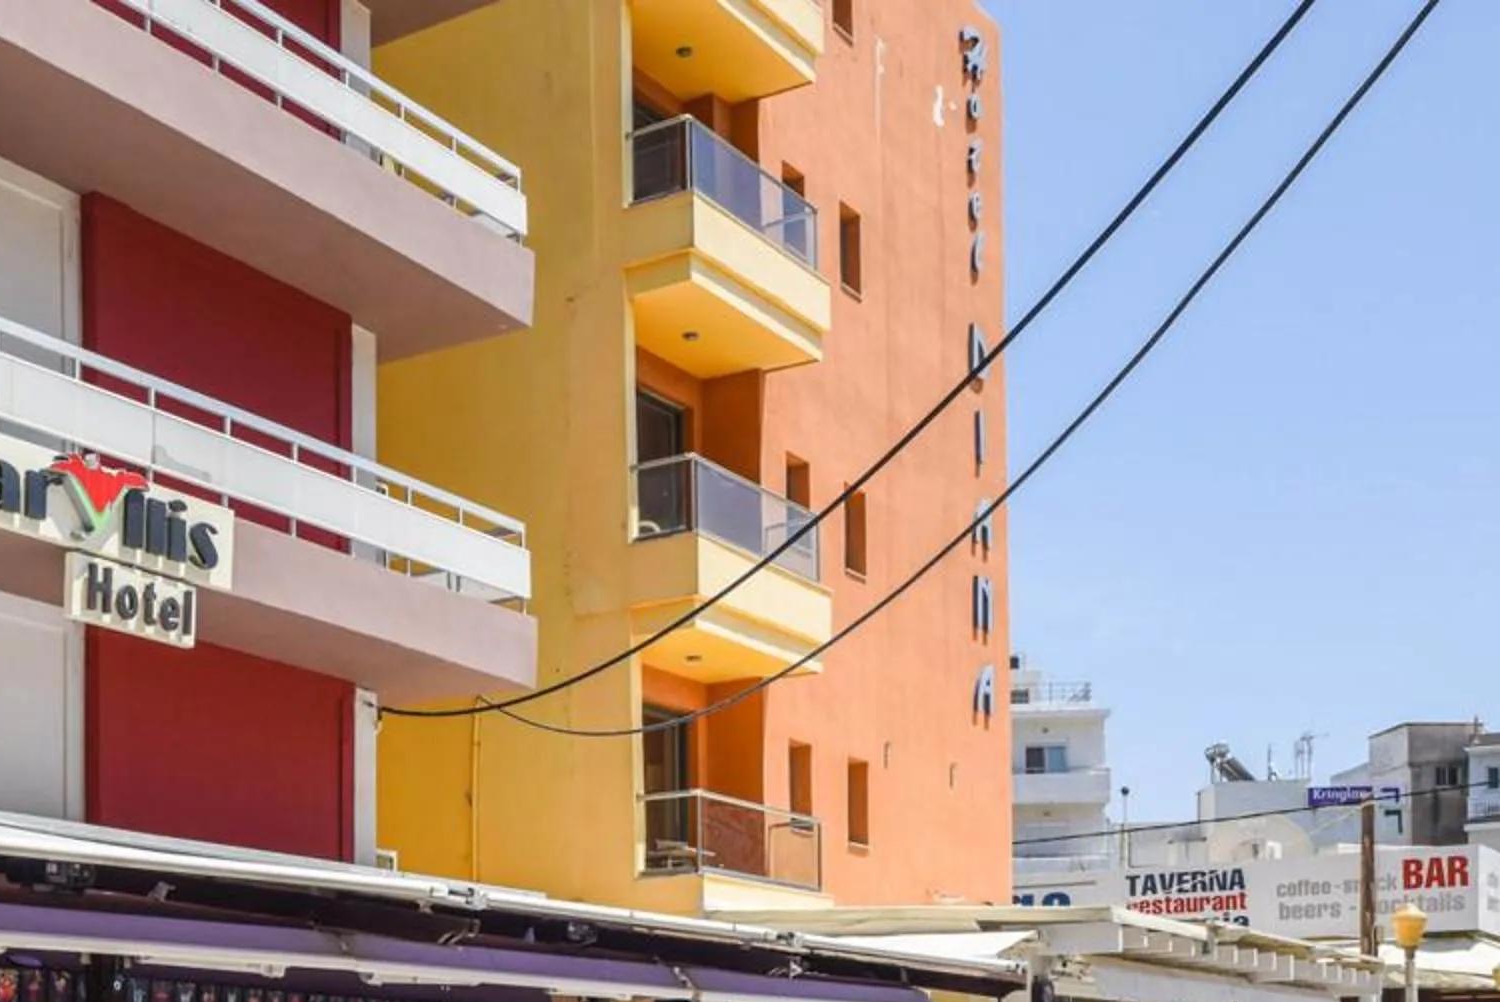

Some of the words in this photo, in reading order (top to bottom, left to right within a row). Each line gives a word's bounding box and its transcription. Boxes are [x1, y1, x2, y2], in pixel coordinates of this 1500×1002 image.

[87, 562, 193, 636] Hotel
[1125, 868, 1247, 897] TAVERNA
[1402, 855, 1469, 889] BAR
[1278, 902, 1342, 921] beers
